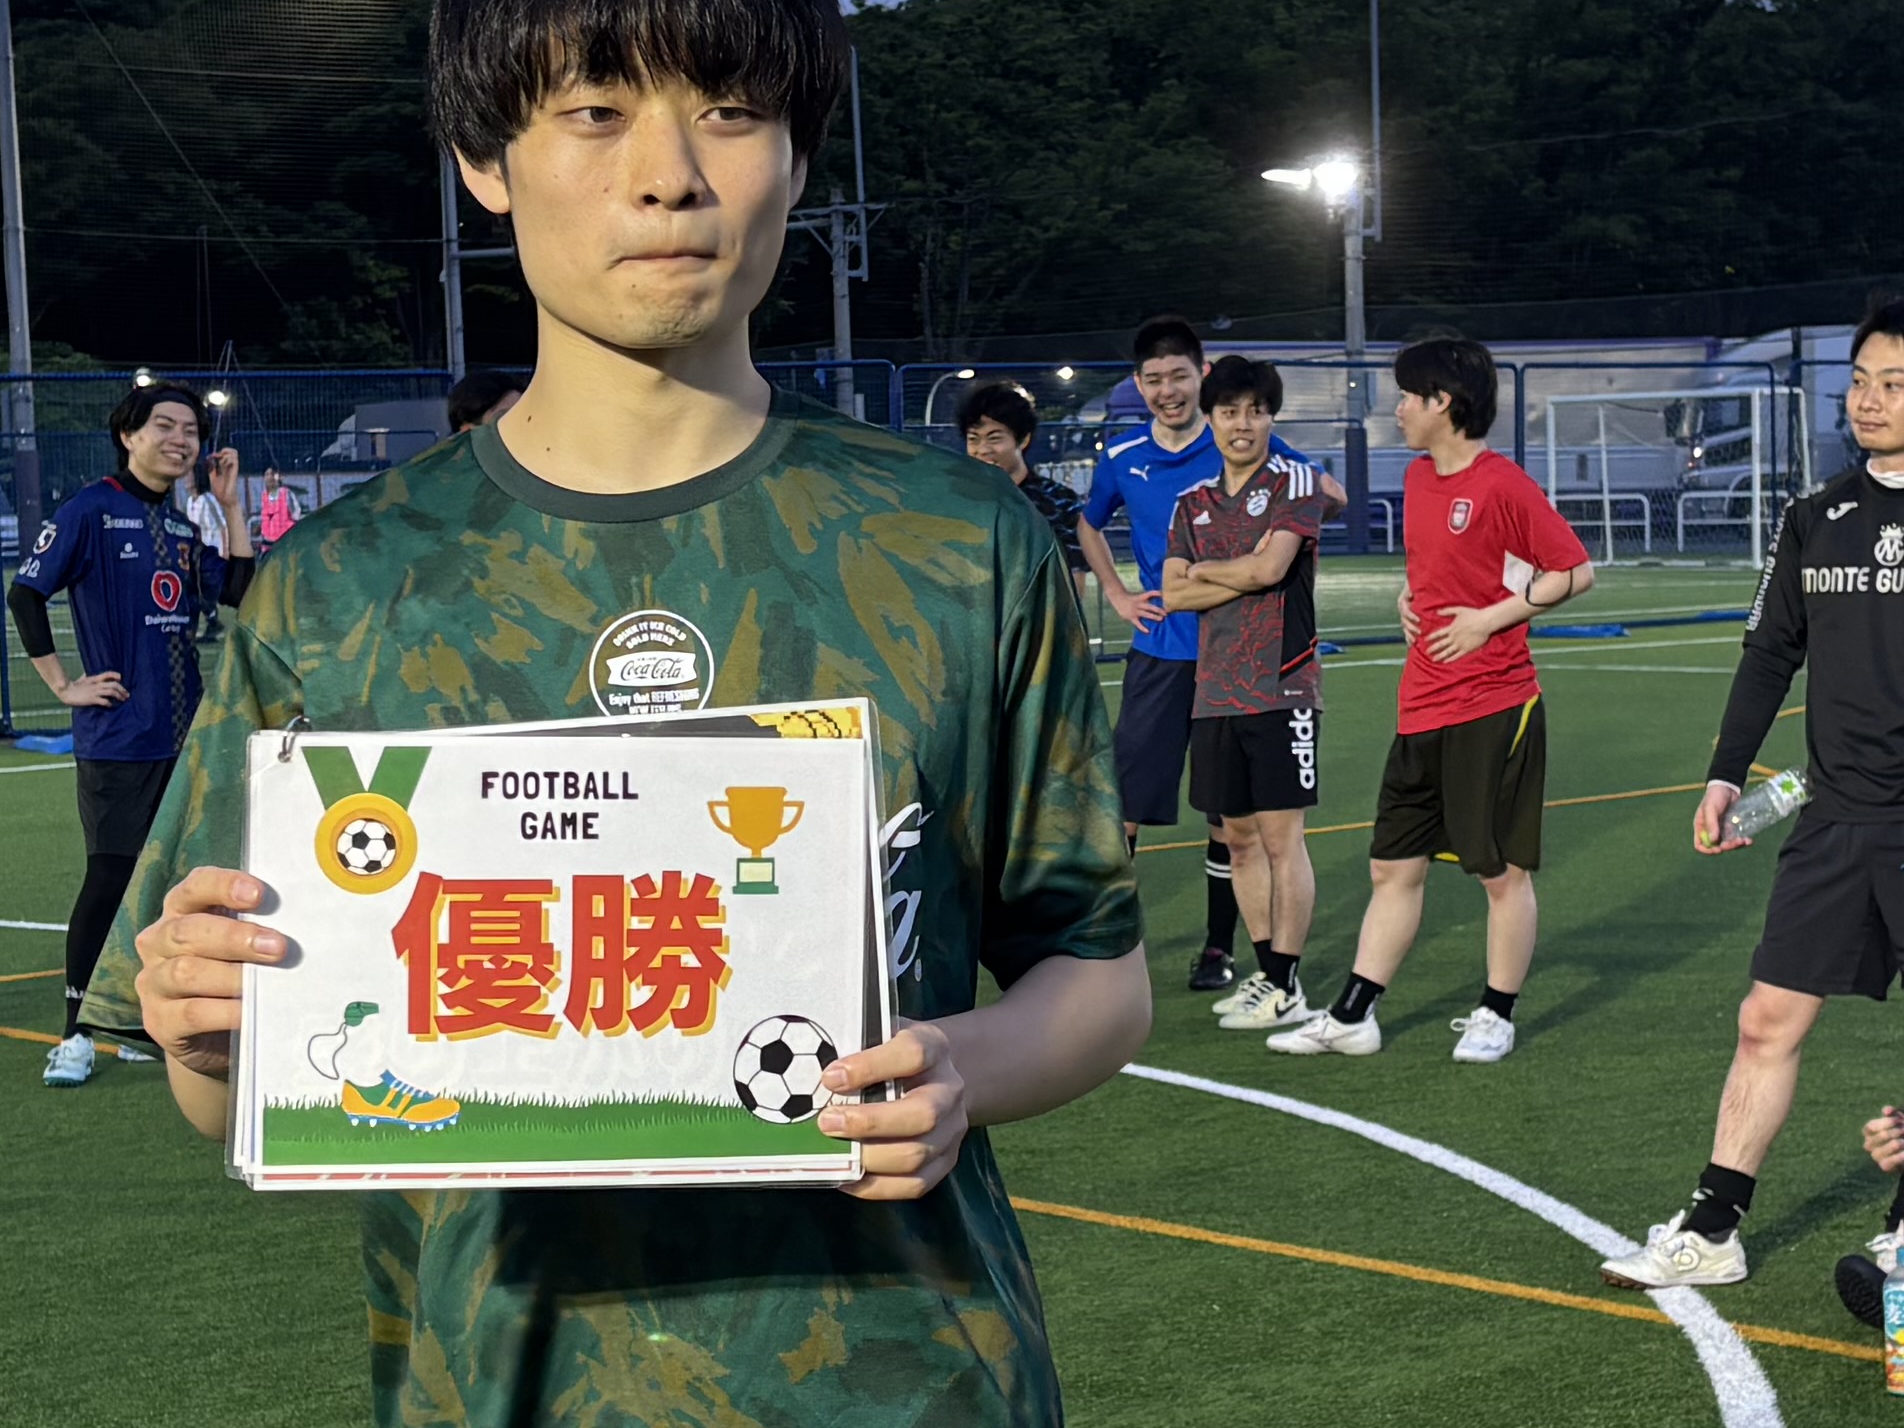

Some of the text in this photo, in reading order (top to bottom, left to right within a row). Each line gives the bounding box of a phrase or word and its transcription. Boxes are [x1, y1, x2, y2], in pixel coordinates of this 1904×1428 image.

[1801, 566, 1870, 594] MONTE
[1289, 707, 1315, 790] adida
[481, 771, 639, 800] FOOTBALL
[520, 811, 600, 840] GAME
[390, 870, 734, 1043] 優勝
